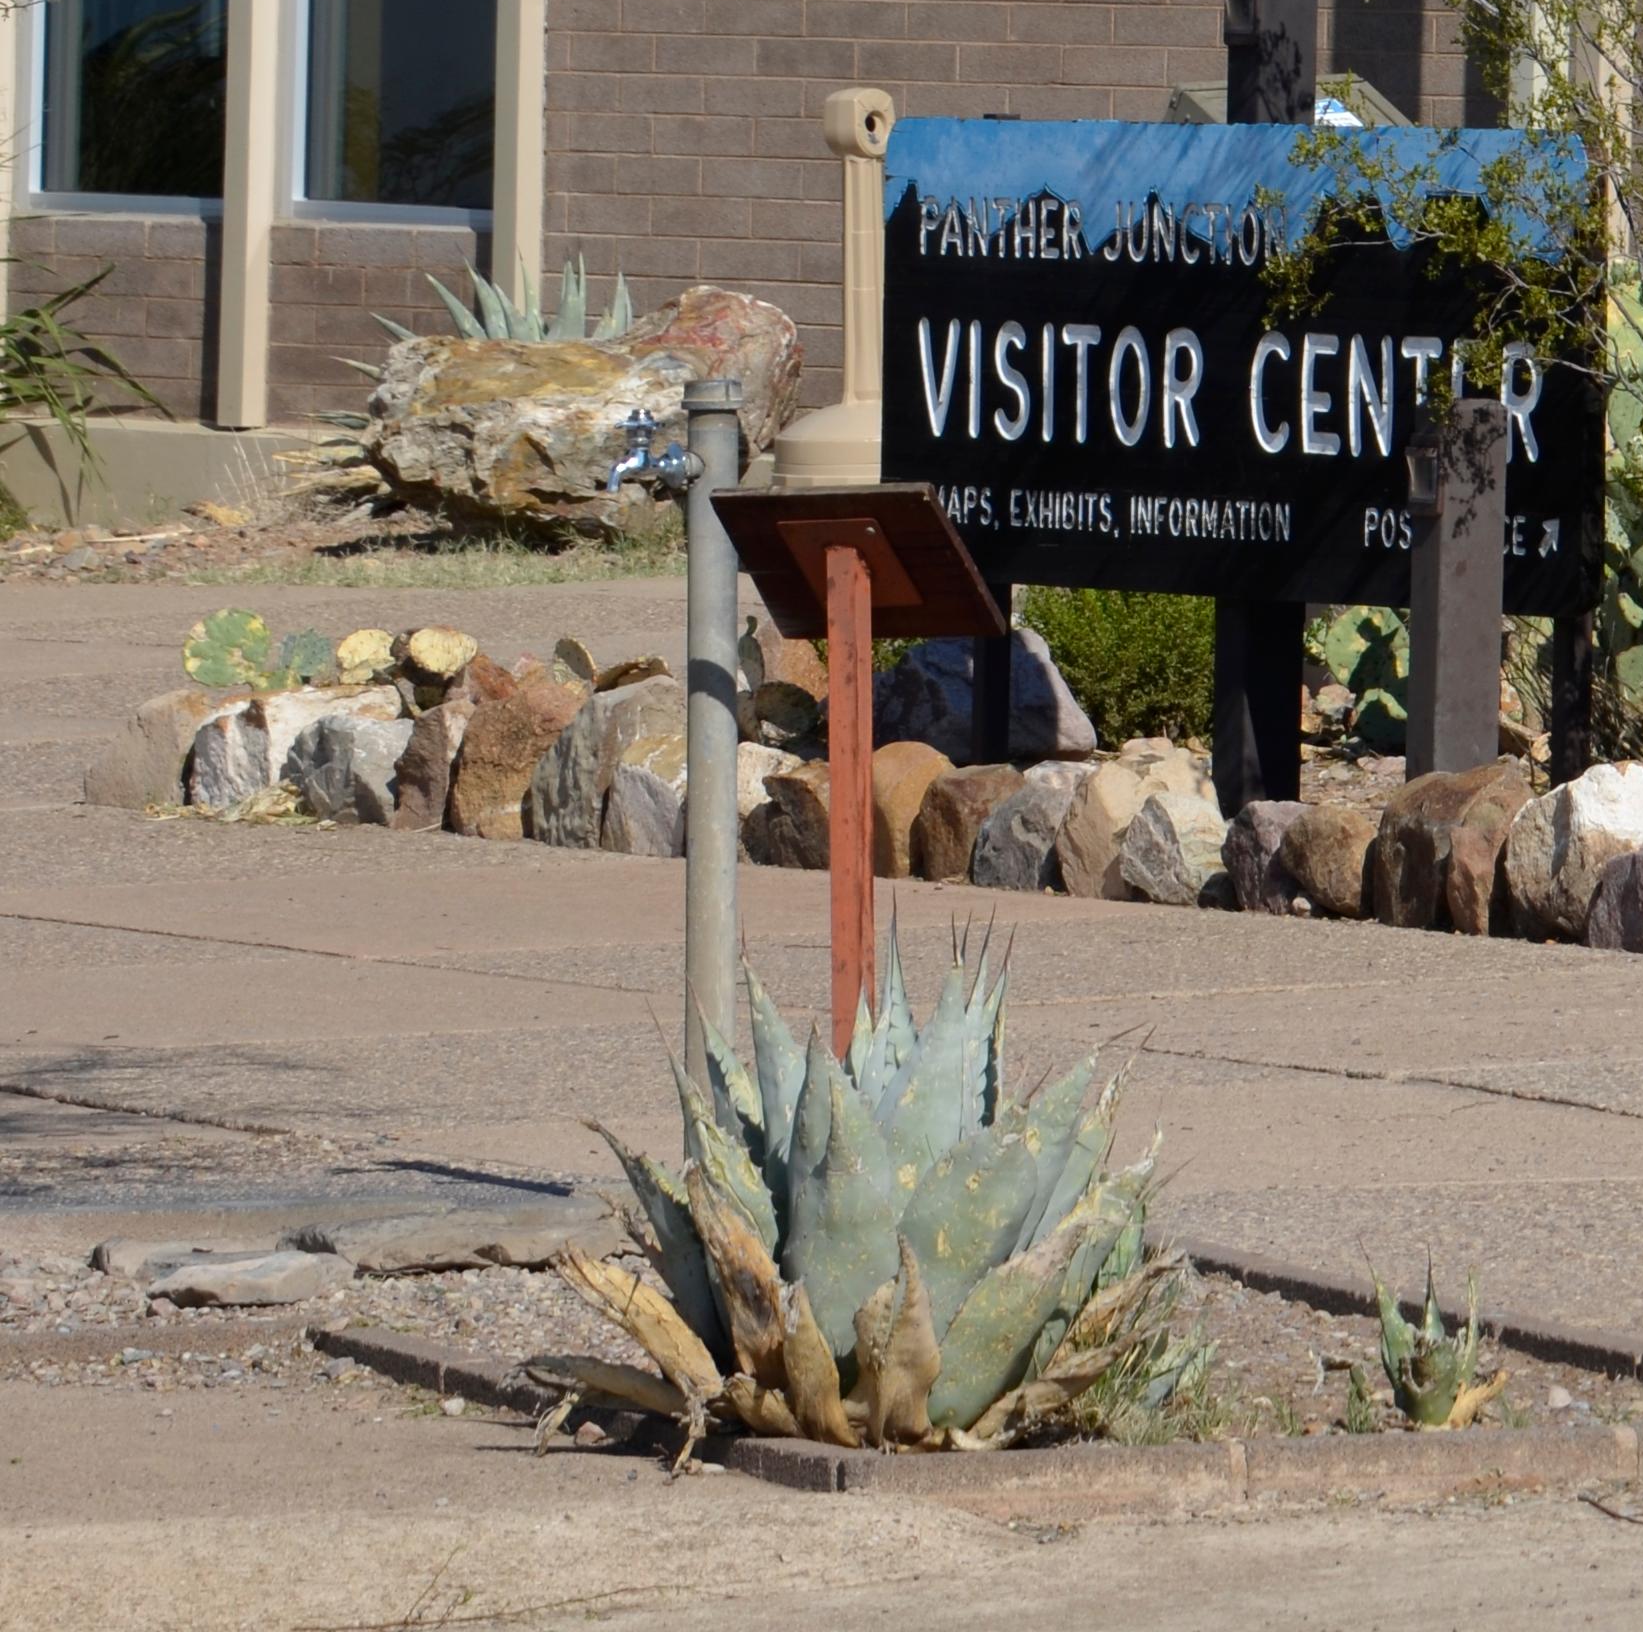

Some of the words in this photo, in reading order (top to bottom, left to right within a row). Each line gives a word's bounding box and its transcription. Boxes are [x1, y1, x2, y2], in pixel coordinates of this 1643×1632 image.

[919, 196, 1082, 259] PANTHER
[1103, 200, 1289, 267] JUNCTION
[918, 316, 1203, 448] VISITOR
[1009, 489, 1119, 538] EXHIBITS,
[1129, 495, 1290, 542] INFORMATION
